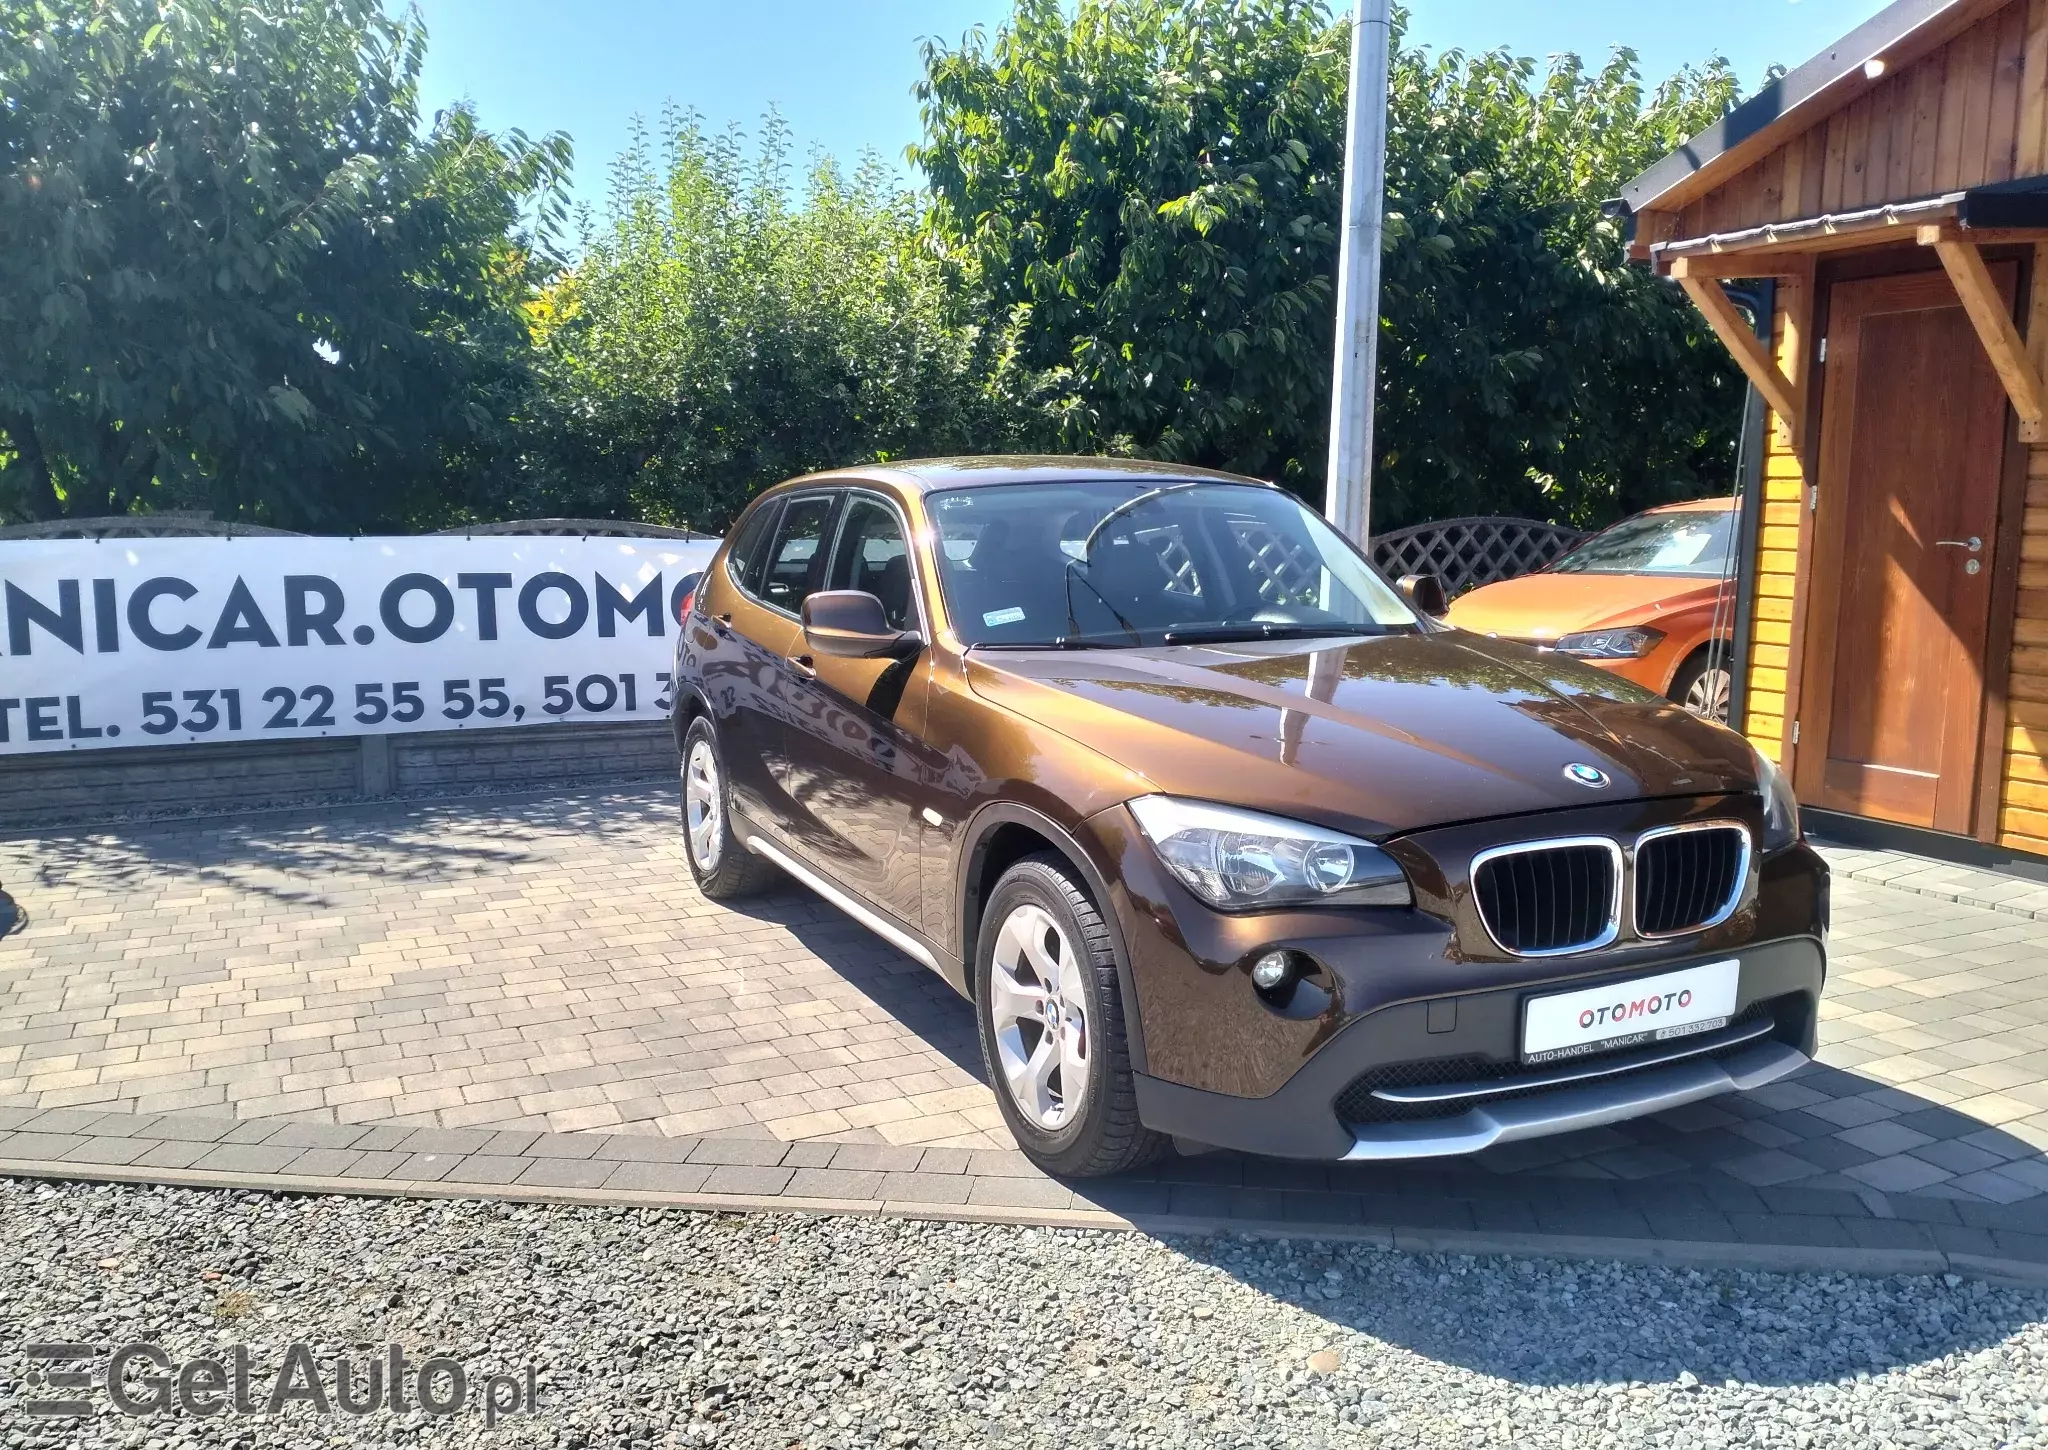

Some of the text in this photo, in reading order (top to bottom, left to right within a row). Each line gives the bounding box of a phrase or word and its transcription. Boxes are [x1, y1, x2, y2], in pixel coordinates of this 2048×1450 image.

[0, 571, 705, 656] NICAR.OTOM
[0, 695, 121, 742] TEL.
[141, 688, 242, 735] 531
[261, 685, 336, 729] 22
[354, 682, 424, 725] 55
[442, 678, 526, 723] 55,
[541, 673, 637, 714] 501
[1579, 989, 1692, 1029] OTOMOTO
[1528, 1043, 1595, 1064] AUTO-HANDEL
[1600, 1032, 1649, 1049] "MANICAR"
